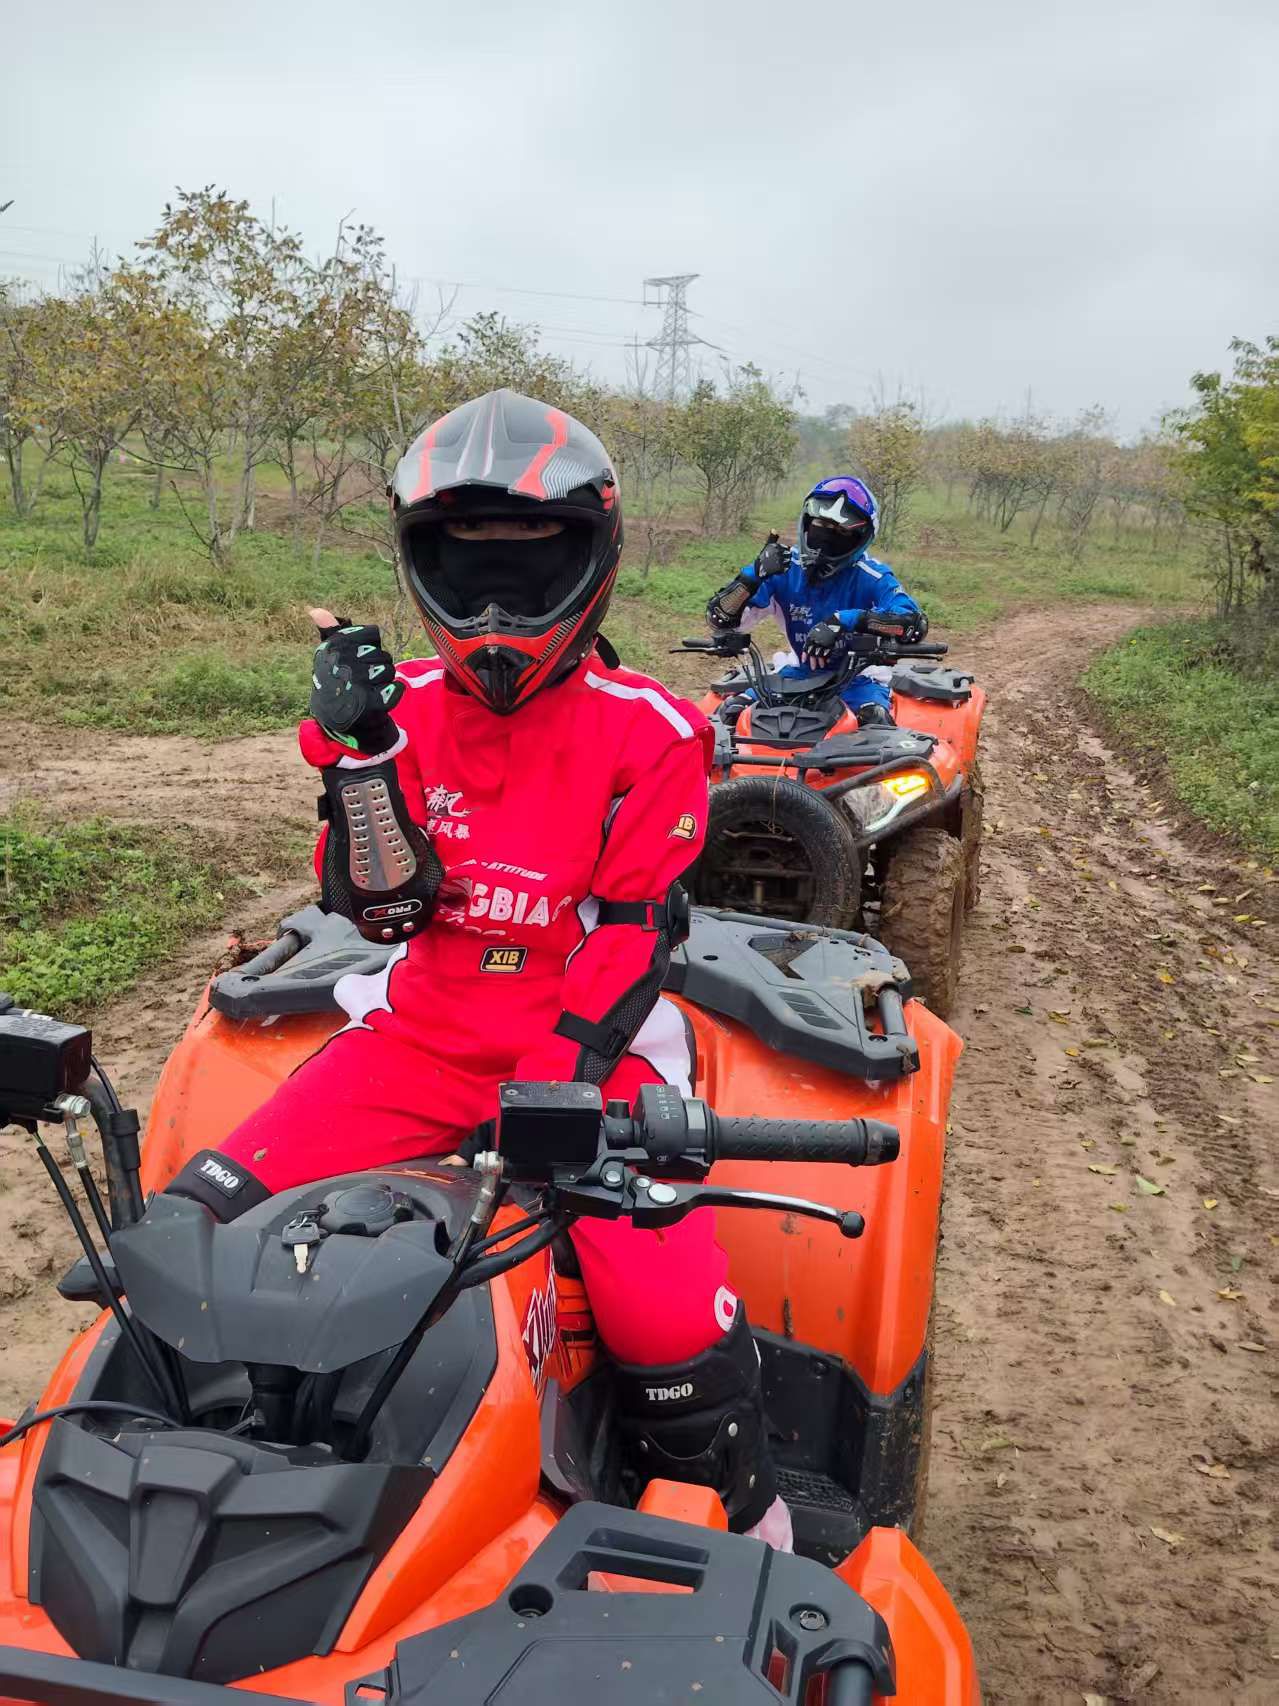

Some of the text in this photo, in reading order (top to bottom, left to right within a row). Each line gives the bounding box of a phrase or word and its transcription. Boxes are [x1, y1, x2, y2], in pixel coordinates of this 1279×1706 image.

[490, 950, 520, 965] XIB
[201, 1158, 239, 1189] TDGO
[646, 1382, 693, 1401] TDGO
